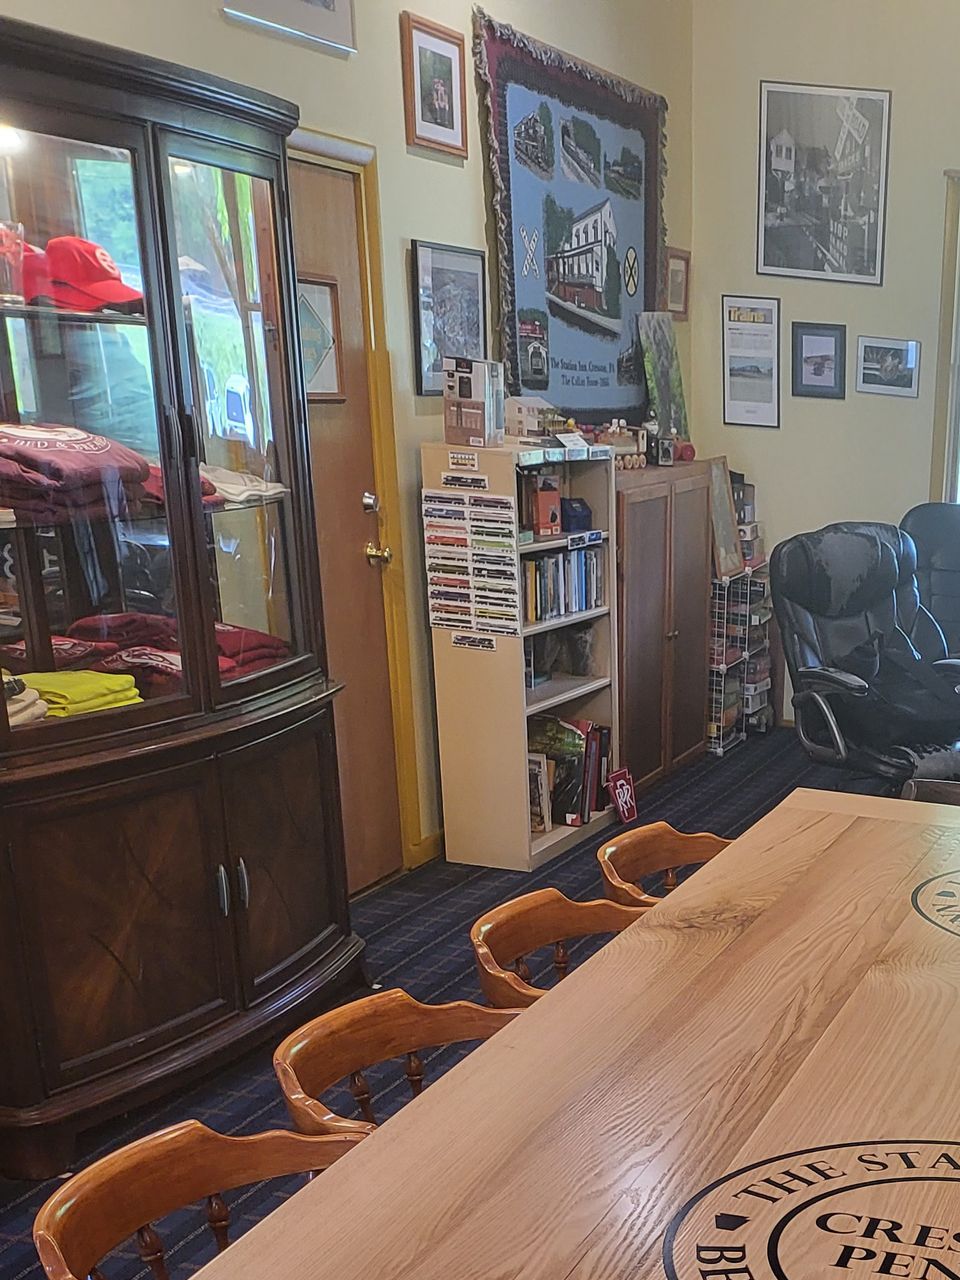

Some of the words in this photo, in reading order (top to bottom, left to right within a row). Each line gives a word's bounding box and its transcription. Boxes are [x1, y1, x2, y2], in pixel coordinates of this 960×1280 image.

[728, 307, 765, 323] Trains
[56, 441, 68, 449] &
[731, 1160, 847, 1204] THE
